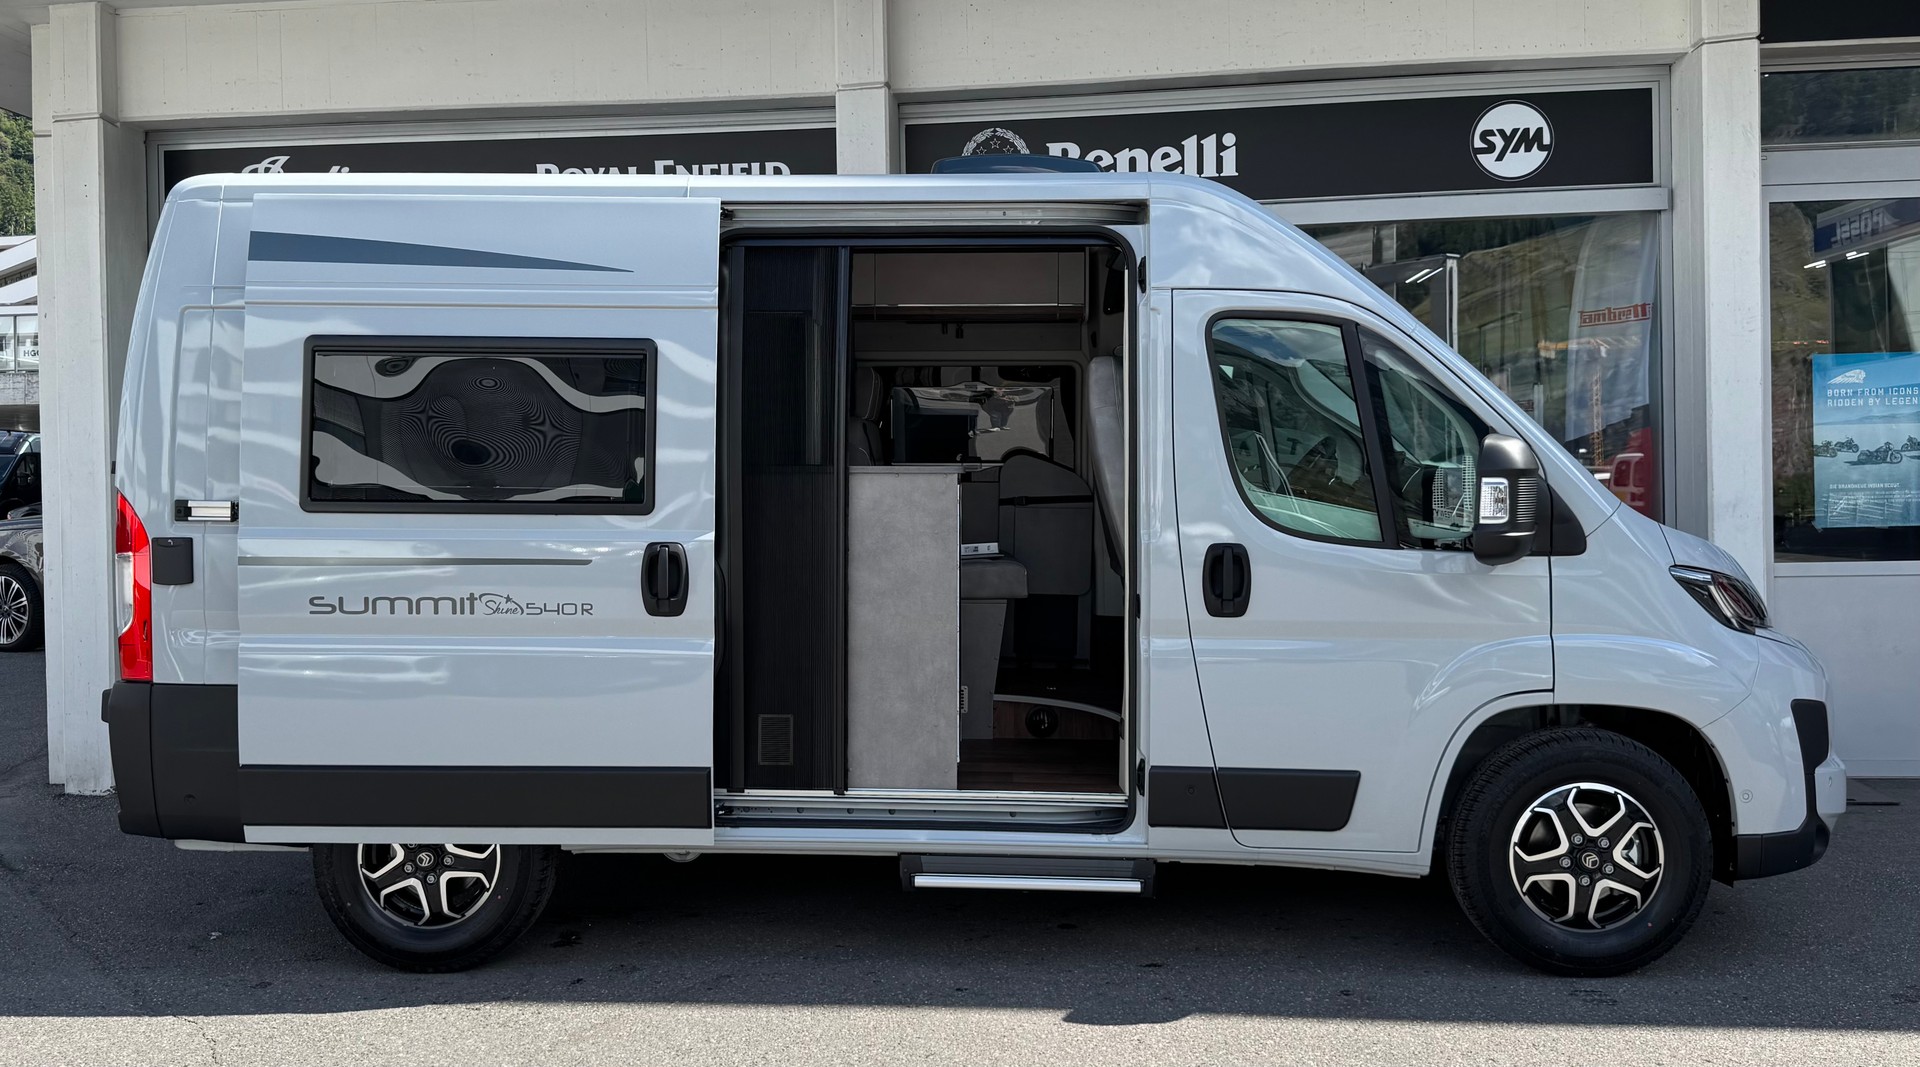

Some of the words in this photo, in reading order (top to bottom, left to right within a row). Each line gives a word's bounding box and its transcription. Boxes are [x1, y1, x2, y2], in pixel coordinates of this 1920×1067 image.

[1474, 127, 1550, 162] SYM
[1828, 389, 1853, 397] BORN
[1857, 388, 1884, 396] FROM
[1889, 387, 1919, 395] ICONS
[1828, 399, 1864, 407] RIDDEN
[1868, 398, 1881, 406] BY
[1885, 397, 1920, 405] LEGEN
